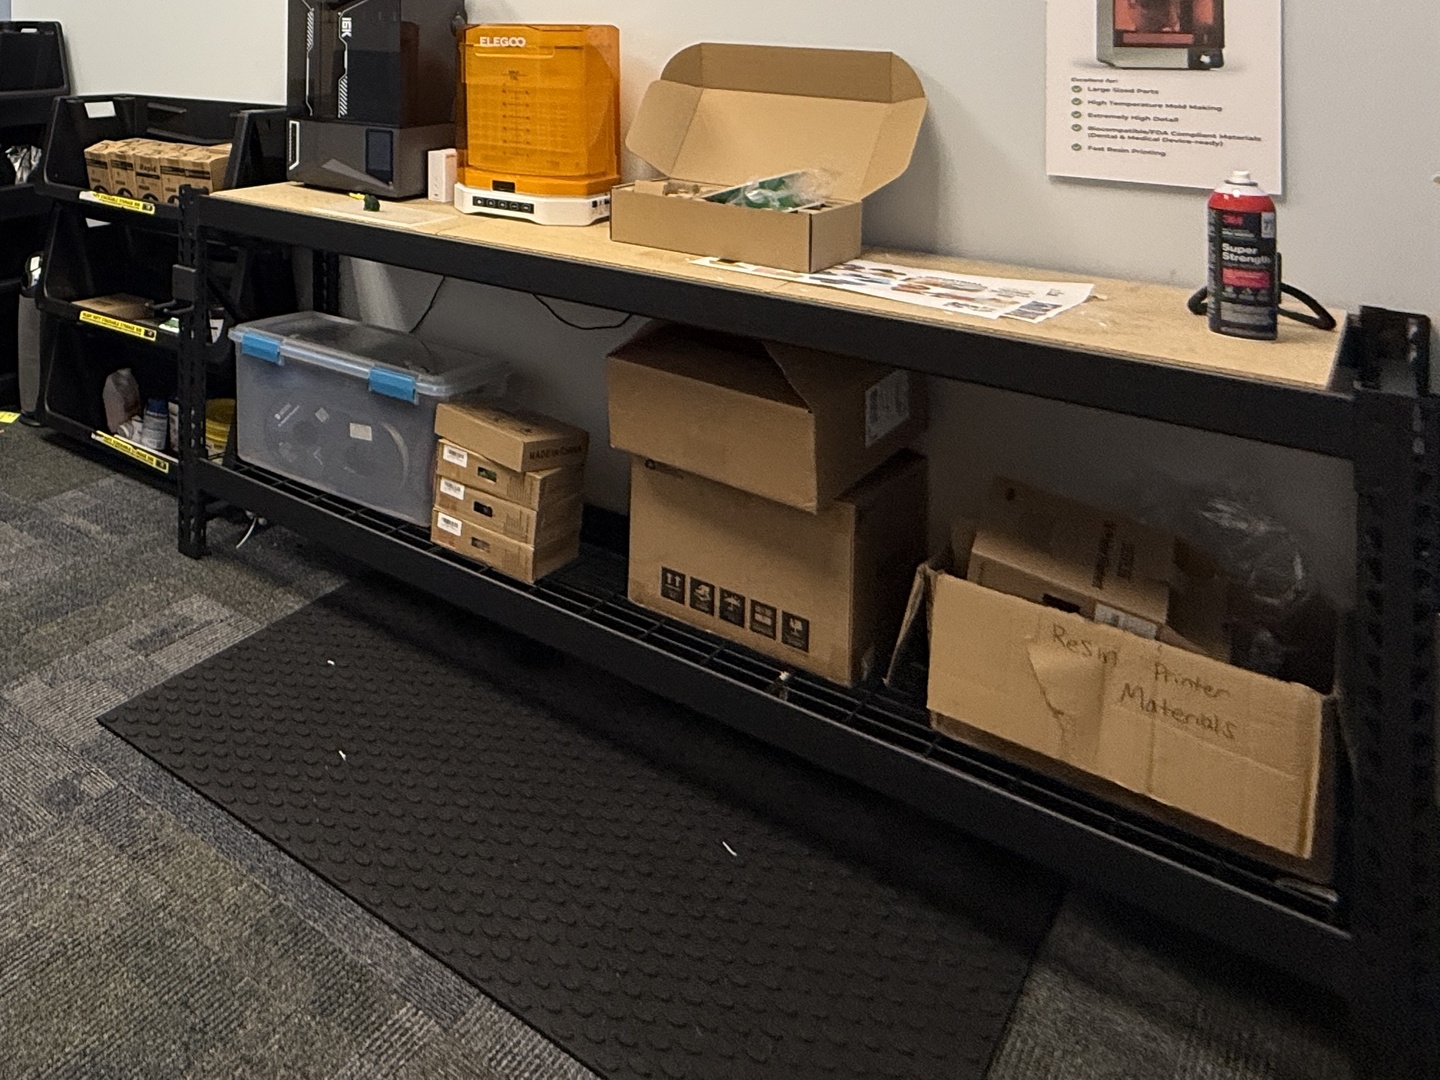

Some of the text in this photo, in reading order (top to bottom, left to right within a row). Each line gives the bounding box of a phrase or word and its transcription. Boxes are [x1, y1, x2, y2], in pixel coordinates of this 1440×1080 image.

[341, 17, 352, 38] 16K
[479, 36, 527, 48] ELEGOO
[1221, 242, 1258, 255] Super
[1053, 623, 1231, 700] Resin Printer
[1119, 682, 1239, 741] Materials
